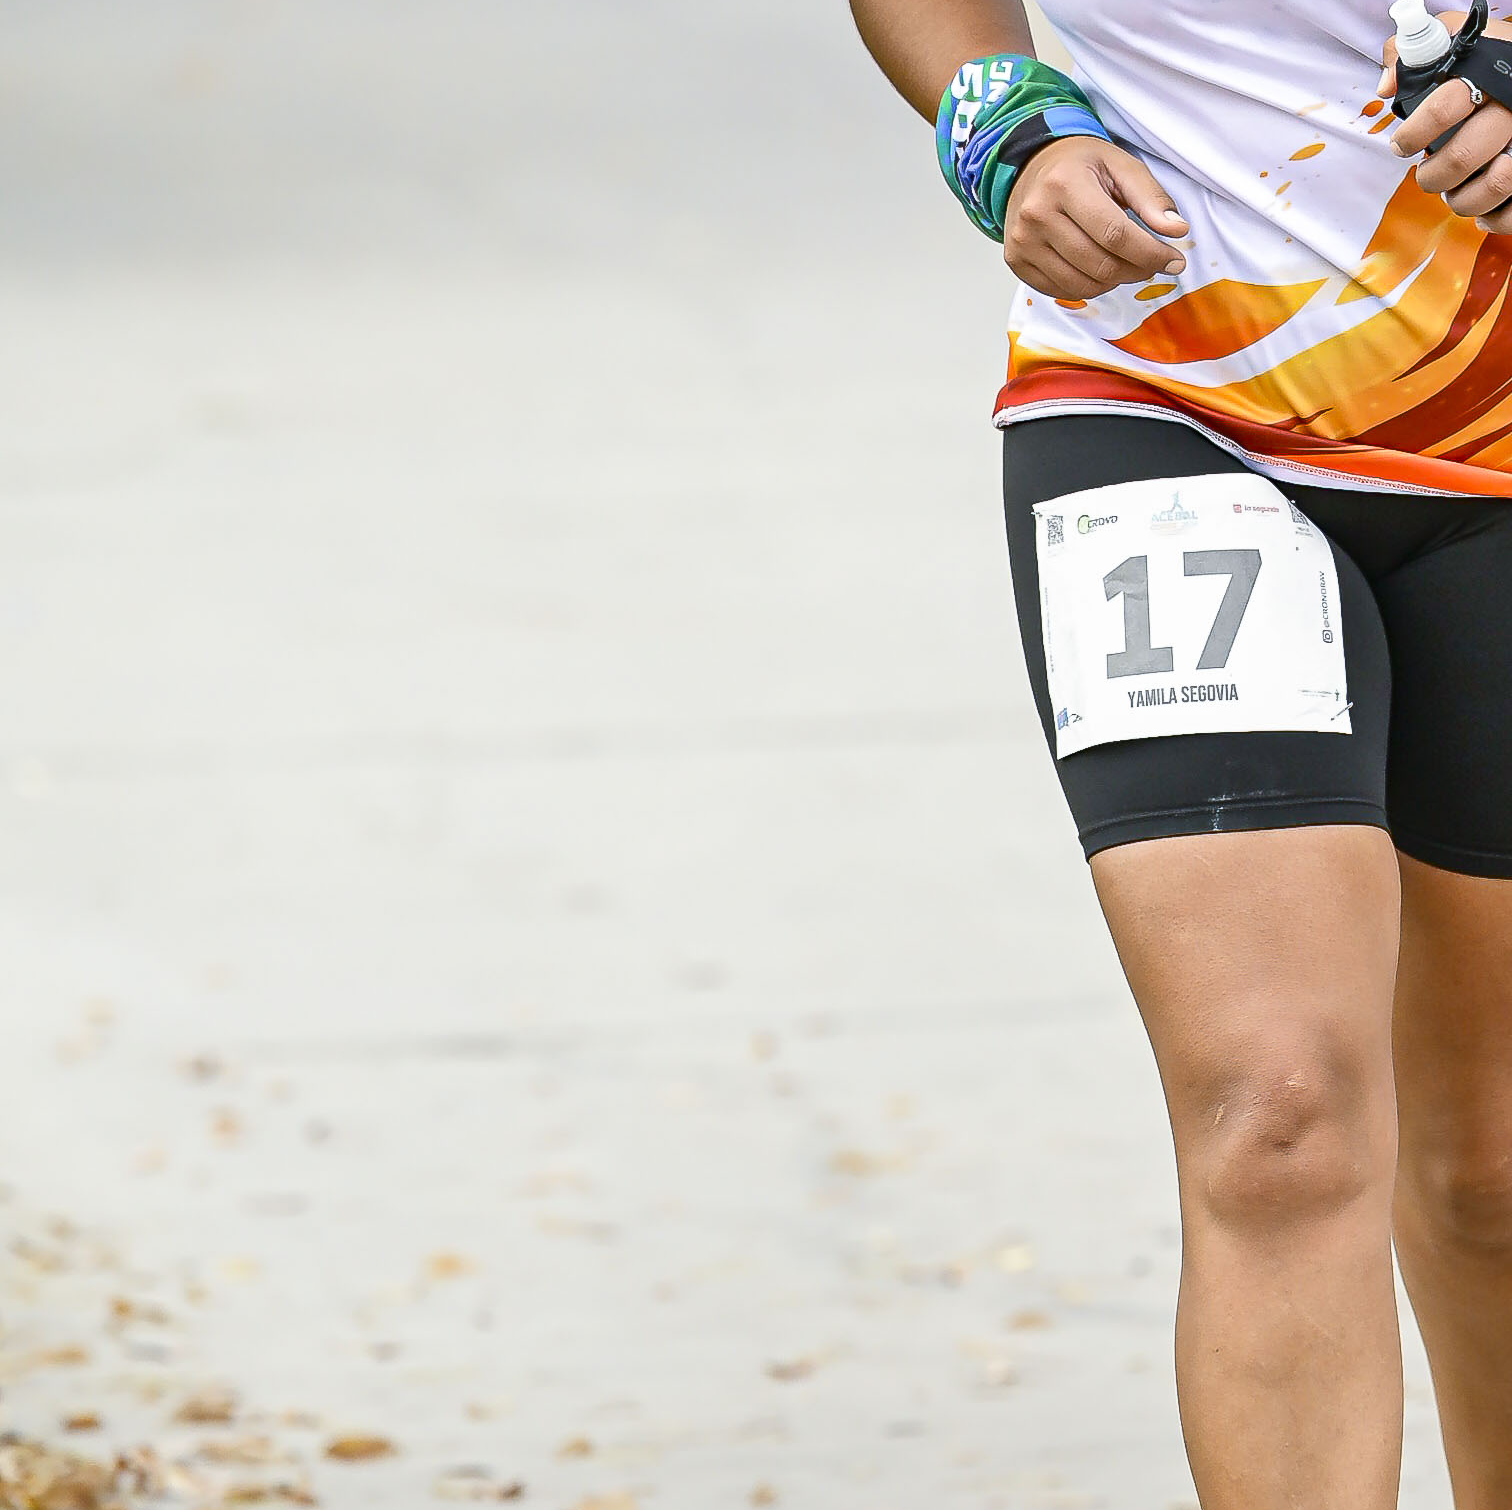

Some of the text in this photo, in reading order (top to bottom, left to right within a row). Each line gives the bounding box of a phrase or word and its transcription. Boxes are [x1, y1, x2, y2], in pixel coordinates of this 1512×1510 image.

[1103, 549, 1262, 679] 17
[1128, 683, 1239, 708] YAMILA SEGOVIA
